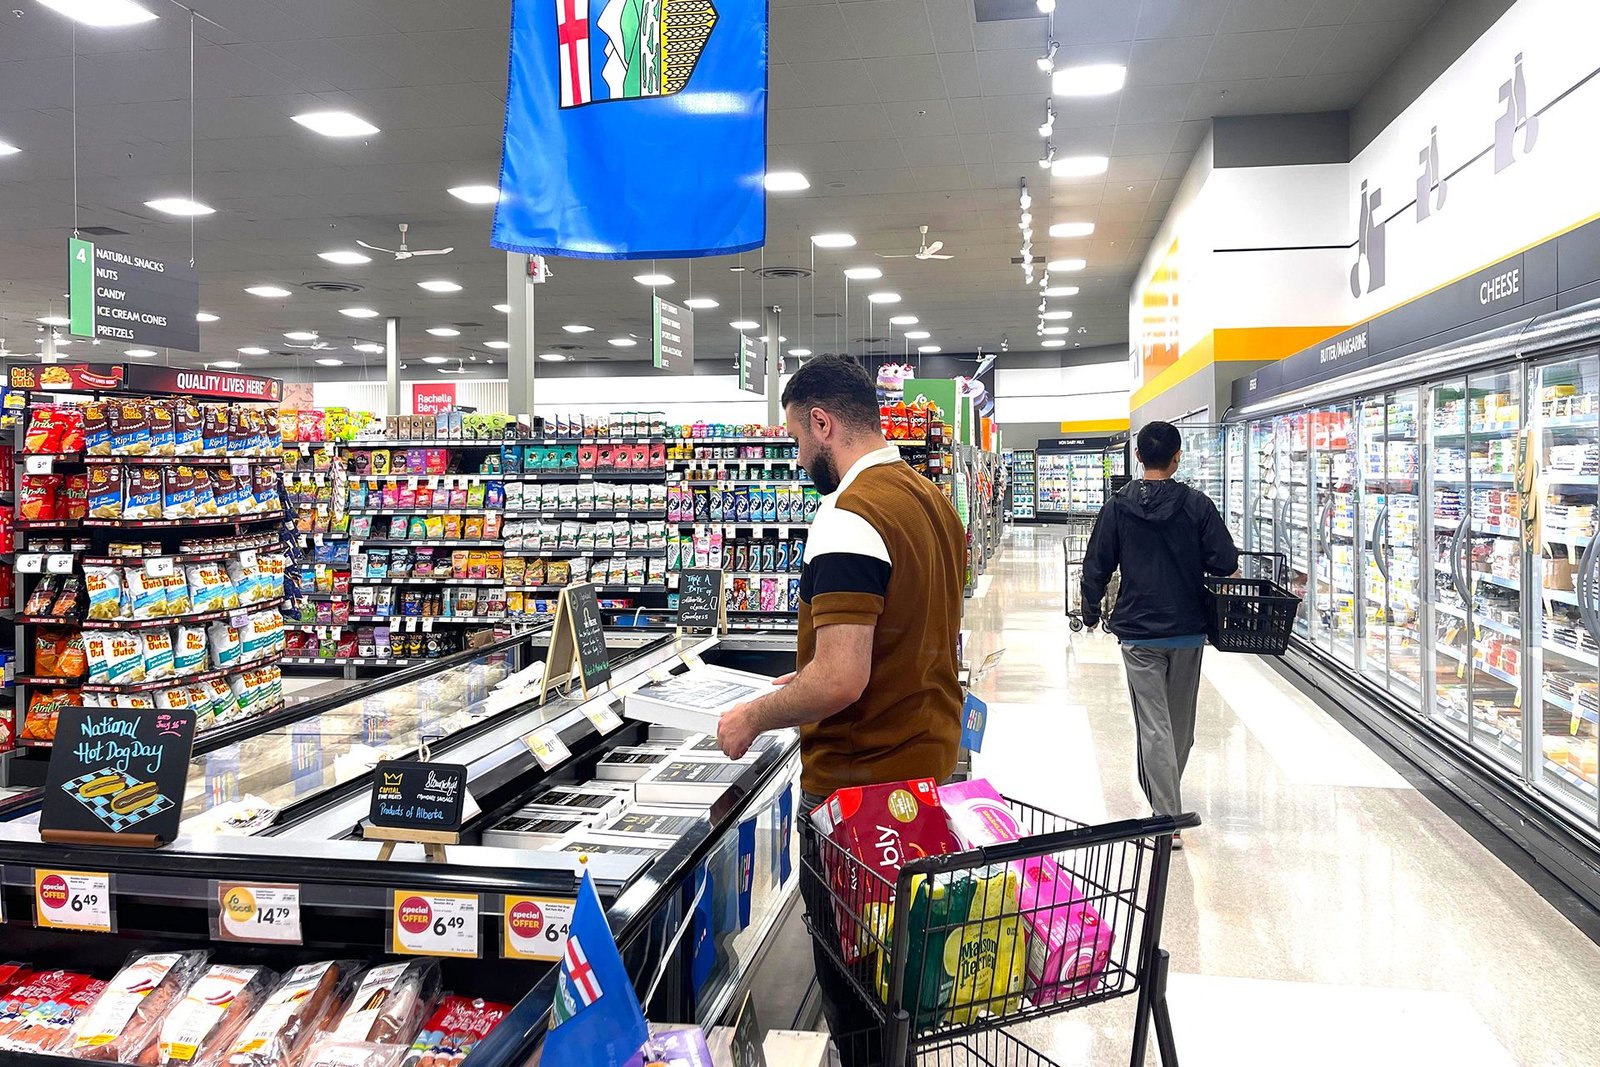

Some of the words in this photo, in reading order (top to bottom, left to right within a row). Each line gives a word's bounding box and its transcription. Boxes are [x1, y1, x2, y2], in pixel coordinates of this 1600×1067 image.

[76, 248, 87, 263] 4
[96, 248, 133, 266] NATURAL
[134, 257, 165, 273] SNACKS
[96, 267, 119, 281] NUTS
[1480, 268, 1519, 305] CHEESE
[97, 287, 126, 301] CANDY
[97, 305, 110, 317] ICE
[112, 307, 140, 322] CREAM
[141, 313, 167, 327] CONES
[97, 325, 134, 339] PRETZELS
[1320, 331, 1367, 364] BUTTER/MARGARINE
[177, 372, 220, 391] QUALITY
[222, 376, 244, 393] LIVES
[246, 380, 264, 395] HERE
[417, 394, 452, 404] Rachelle
[704, 574, 712, 586] A
[81, 715, 142, 739] National
[73, 741, 104, 764] Hot
[105, 740, 131, 772] Dog
[131, 740, 164, 774] Day
[379, 802, 404, 817] Products
[405, 805, 415, 819] of
[416, 806, 444, 820] Alberta
[42, 883, 66, 892] special
[43, 891, 66, 900] OFFER
[402, 906, 429, 914] special
[512, 911, 540, 919] special
[402, 914, 429, 923] OFFER
[512, 919, 540, 928] OFFER
